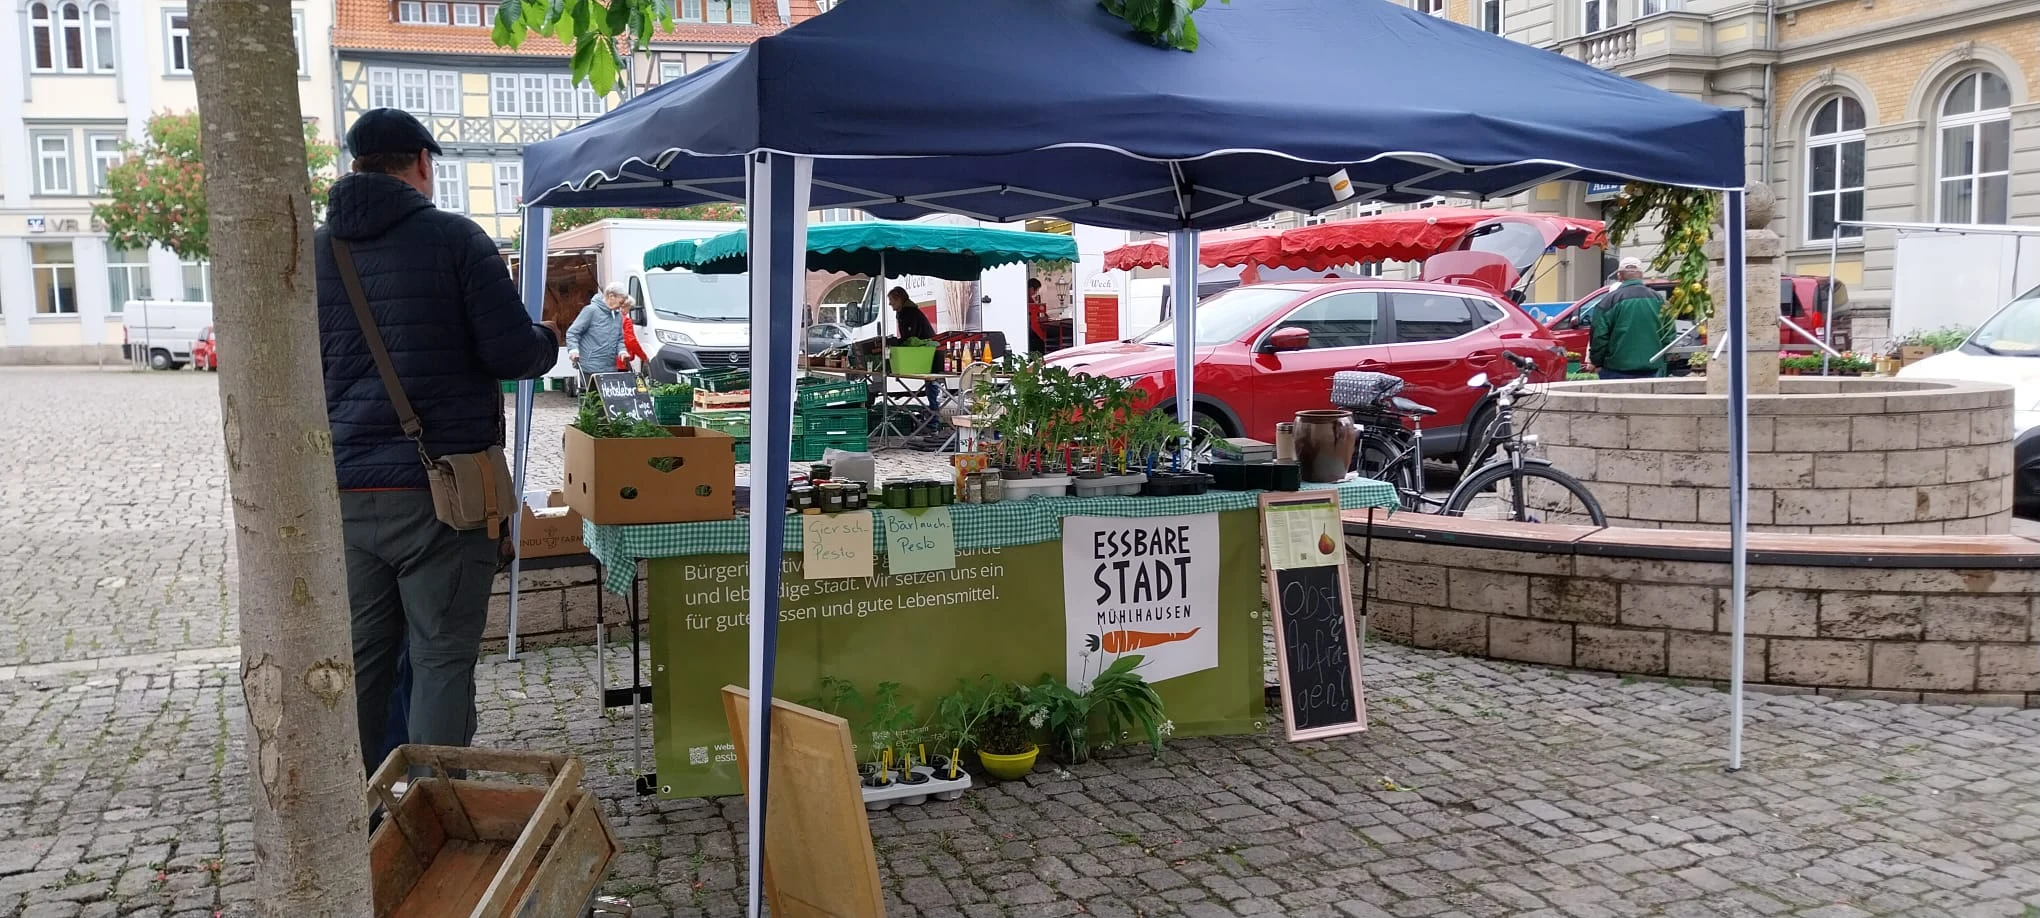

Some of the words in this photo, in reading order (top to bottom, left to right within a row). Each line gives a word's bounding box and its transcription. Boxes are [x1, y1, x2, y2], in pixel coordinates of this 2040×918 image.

[50, 218, 79, 232] VR
[897, 535, 936, 554] Pesto
[1094, 525, 1191, 560] ESSBARE
[813, 544, 856, 561] Pesto
[685, 587, 720, 606] und
[814, 578, 860, 595] Stadt.
[864, 573, 891, 589] Wir
[895, 569, 946, 587] setzen
[950, 567, 977, 581] uns
[980, 563, 1004, 577] ein
[1093, 556, 1192, 606] STADT
[685, 613, 712, 630] für
[779, 606, 817, 622] ssen
[822, 598, 853, 617] und
[857, 597, 893, 618] gute
[898, 585, 1000, 609] Lebensmittel.
[1097, 605, 1191, 625] MÜHLHAUSEN
[714, 743, 735, 751] Webs
[715, 752, 737, 762] essb
